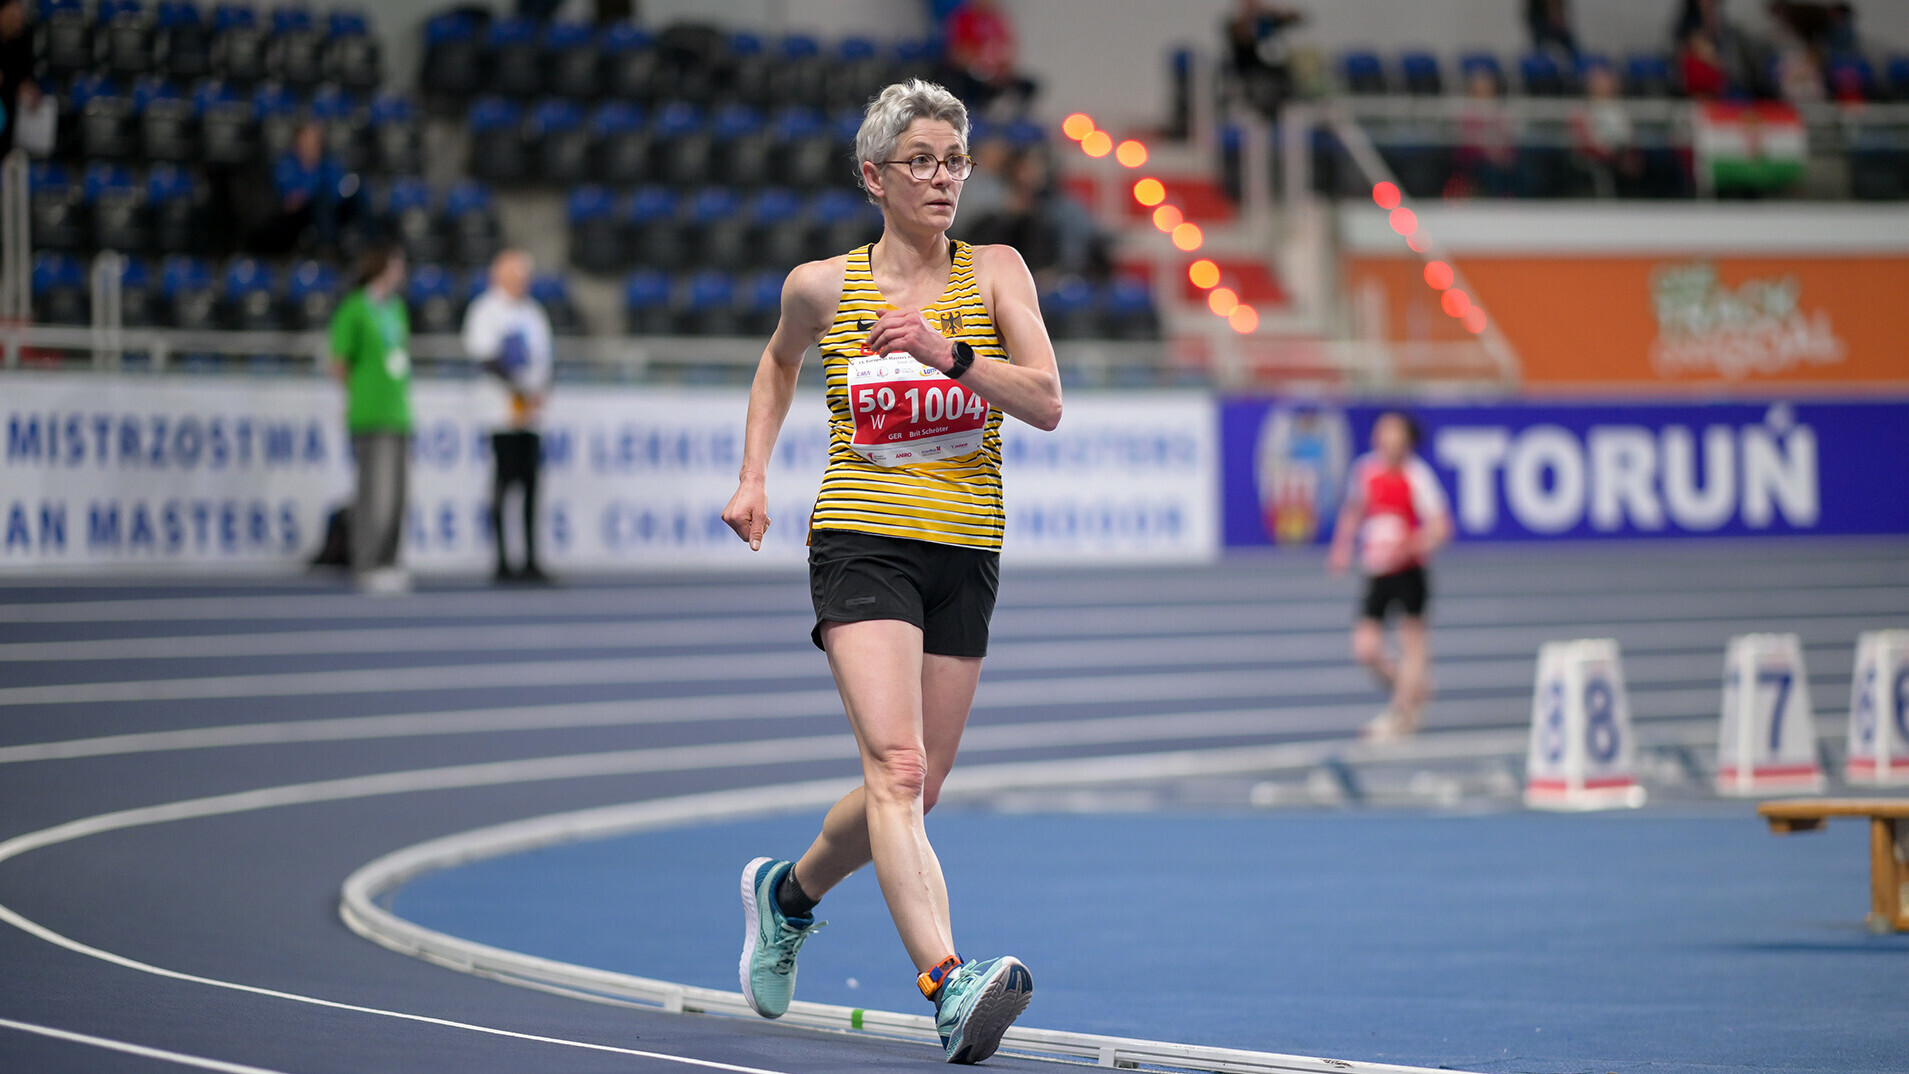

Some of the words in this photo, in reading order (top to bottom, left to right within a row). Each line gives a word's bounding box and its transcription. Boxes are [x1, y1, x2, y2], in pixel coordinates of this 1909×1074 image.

[858, 387, 896, 413] 50
[904, 386, 984, 424] 1004
[870, 414, 886, 430] W
[6, 412, 328, 468] MISTRZOSTWA
[888, 432, 903, 440] GER
[909, 430, 921, 438] Brit
[921, 425, 949, 436] Schröter
[1436, 404, 1819, 532] TORUŃ
[86, 501, 299, 553] MASTERS
[1582, 676, 1621, 765] 8
[1755, 670, 1795, 754] 7
